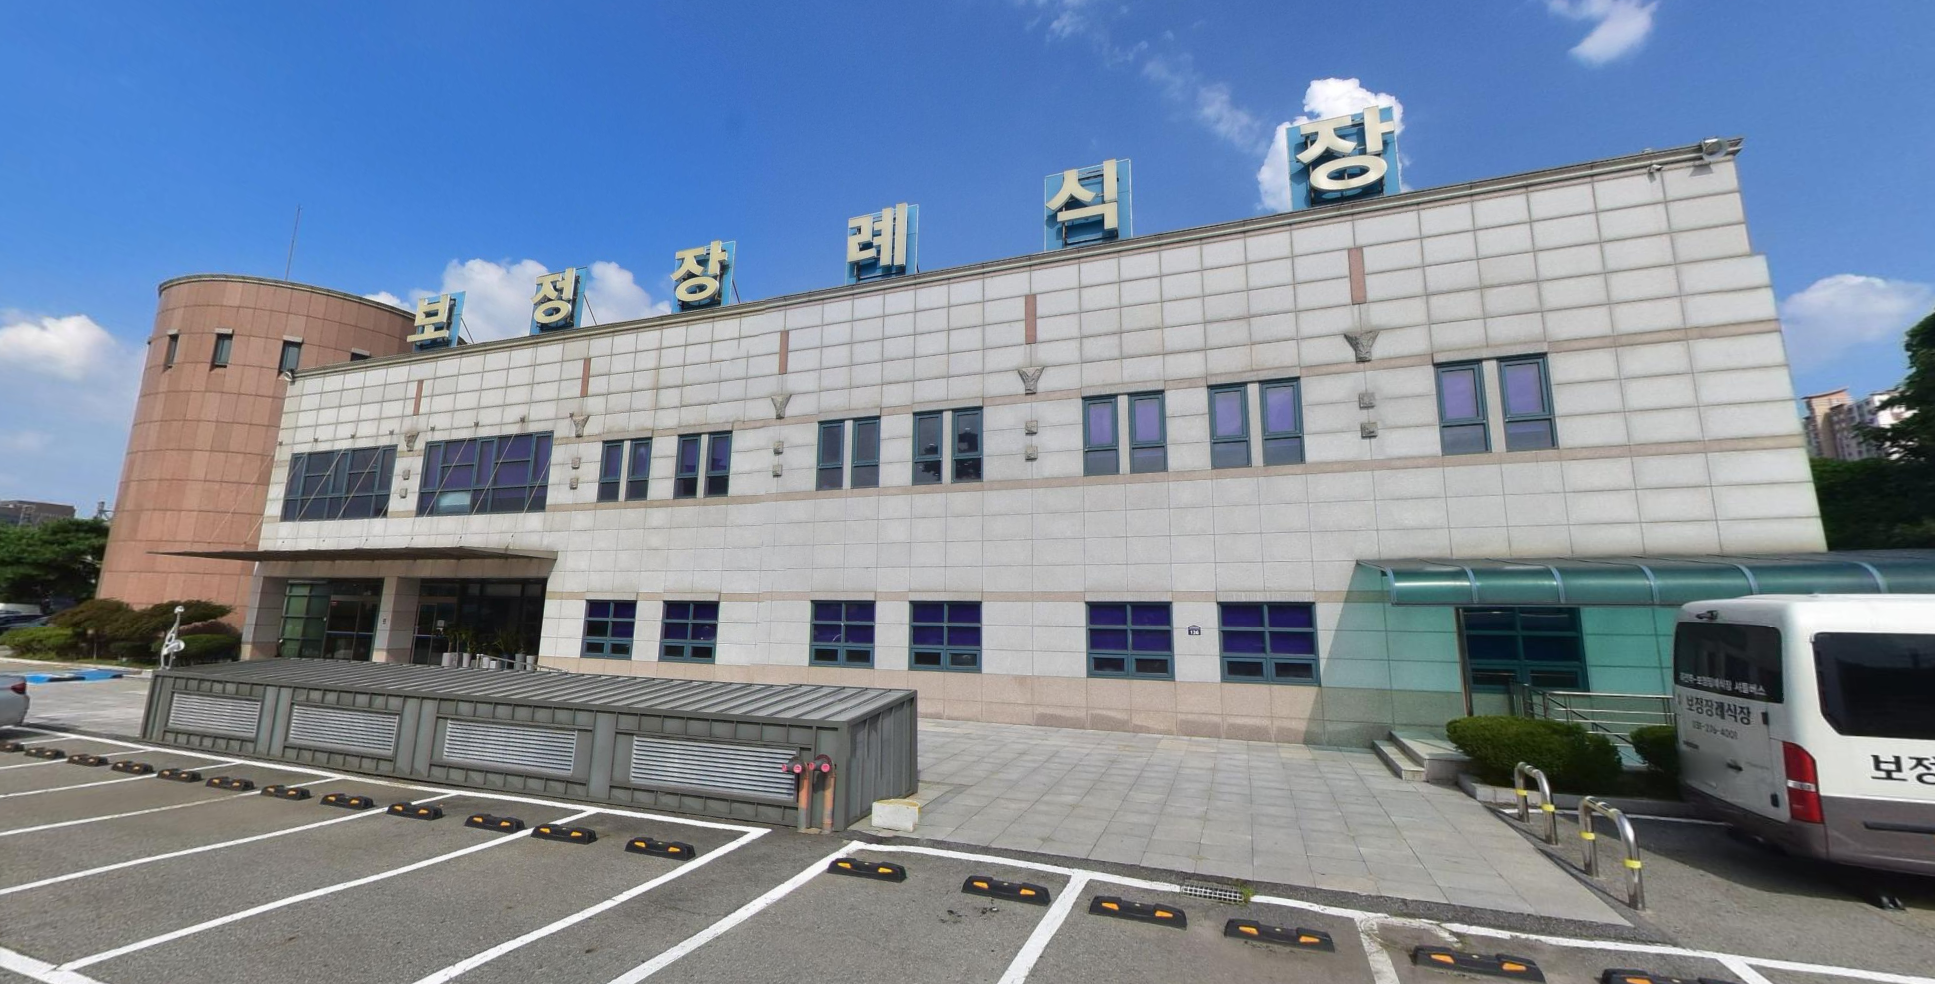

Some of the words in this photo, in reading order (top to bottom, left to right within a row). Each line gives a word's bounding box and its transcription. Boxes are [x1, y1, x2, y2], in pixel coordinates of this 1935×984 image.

[407, 105, 1395, 343] 보정장례식장
[1686, 695, 1751, 725] 보정장례식장
[1870, 754, 1935, 785] 보정
